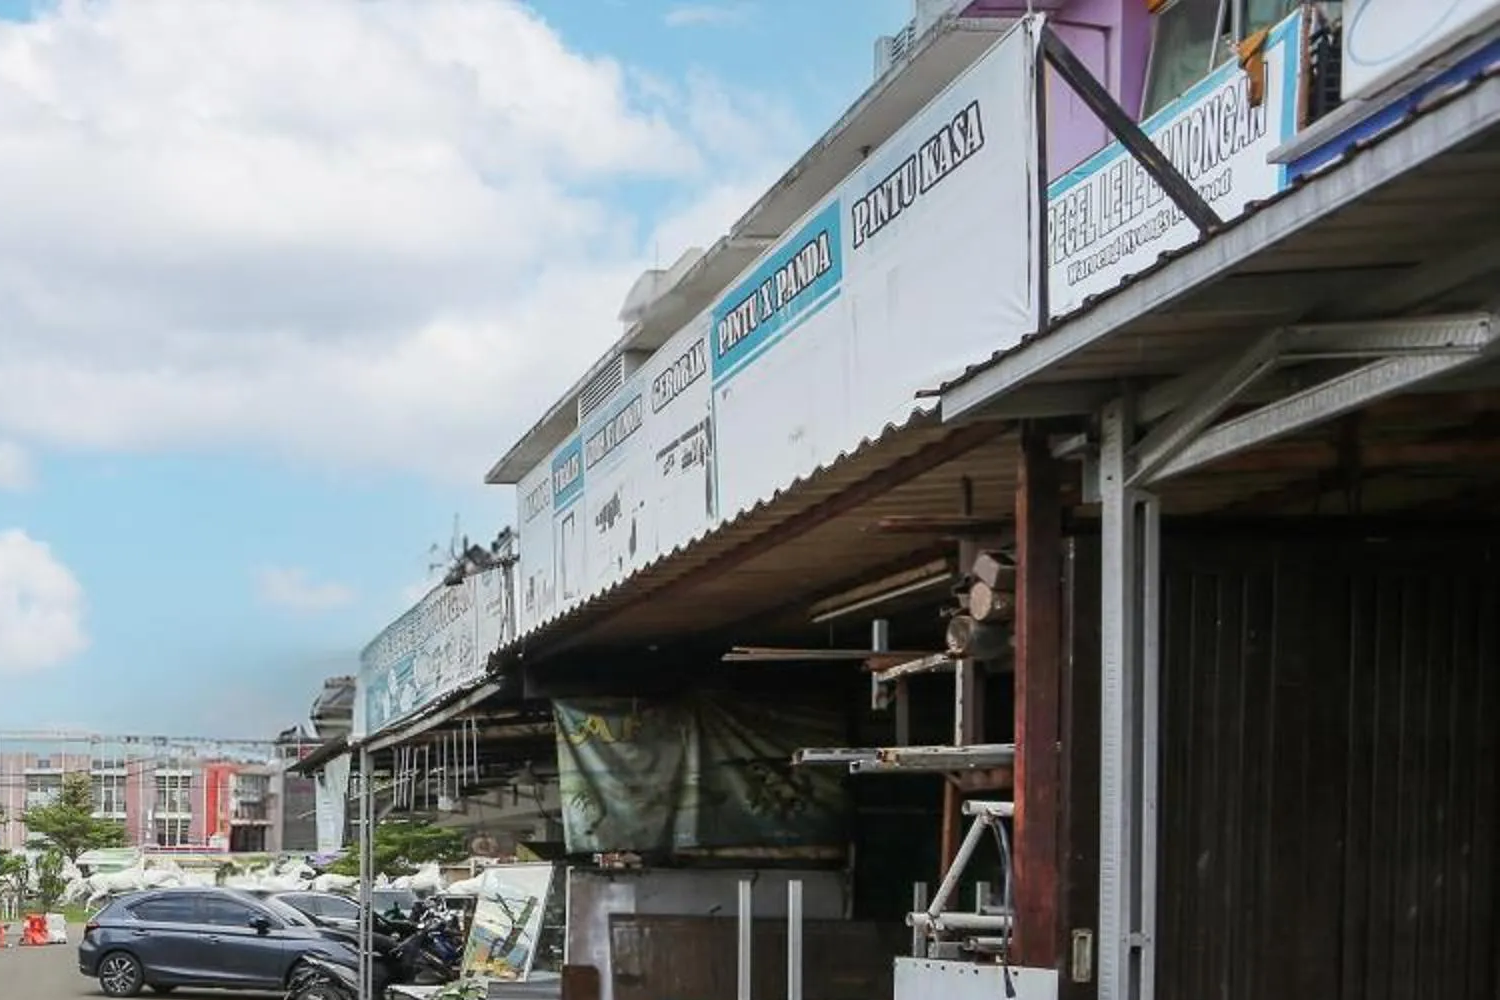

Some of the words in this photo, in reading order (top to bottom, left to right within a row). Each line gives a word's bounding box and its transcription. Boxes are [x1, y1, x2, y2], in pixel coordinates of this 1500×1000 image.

[852, 154, 916, 249] PINTU
[919, 100, 985, 195] KASA
[717, 289, 759, 360] PINTU
[760, 277, 774, 323] X
[774, 230, 832, 312] PANDA
